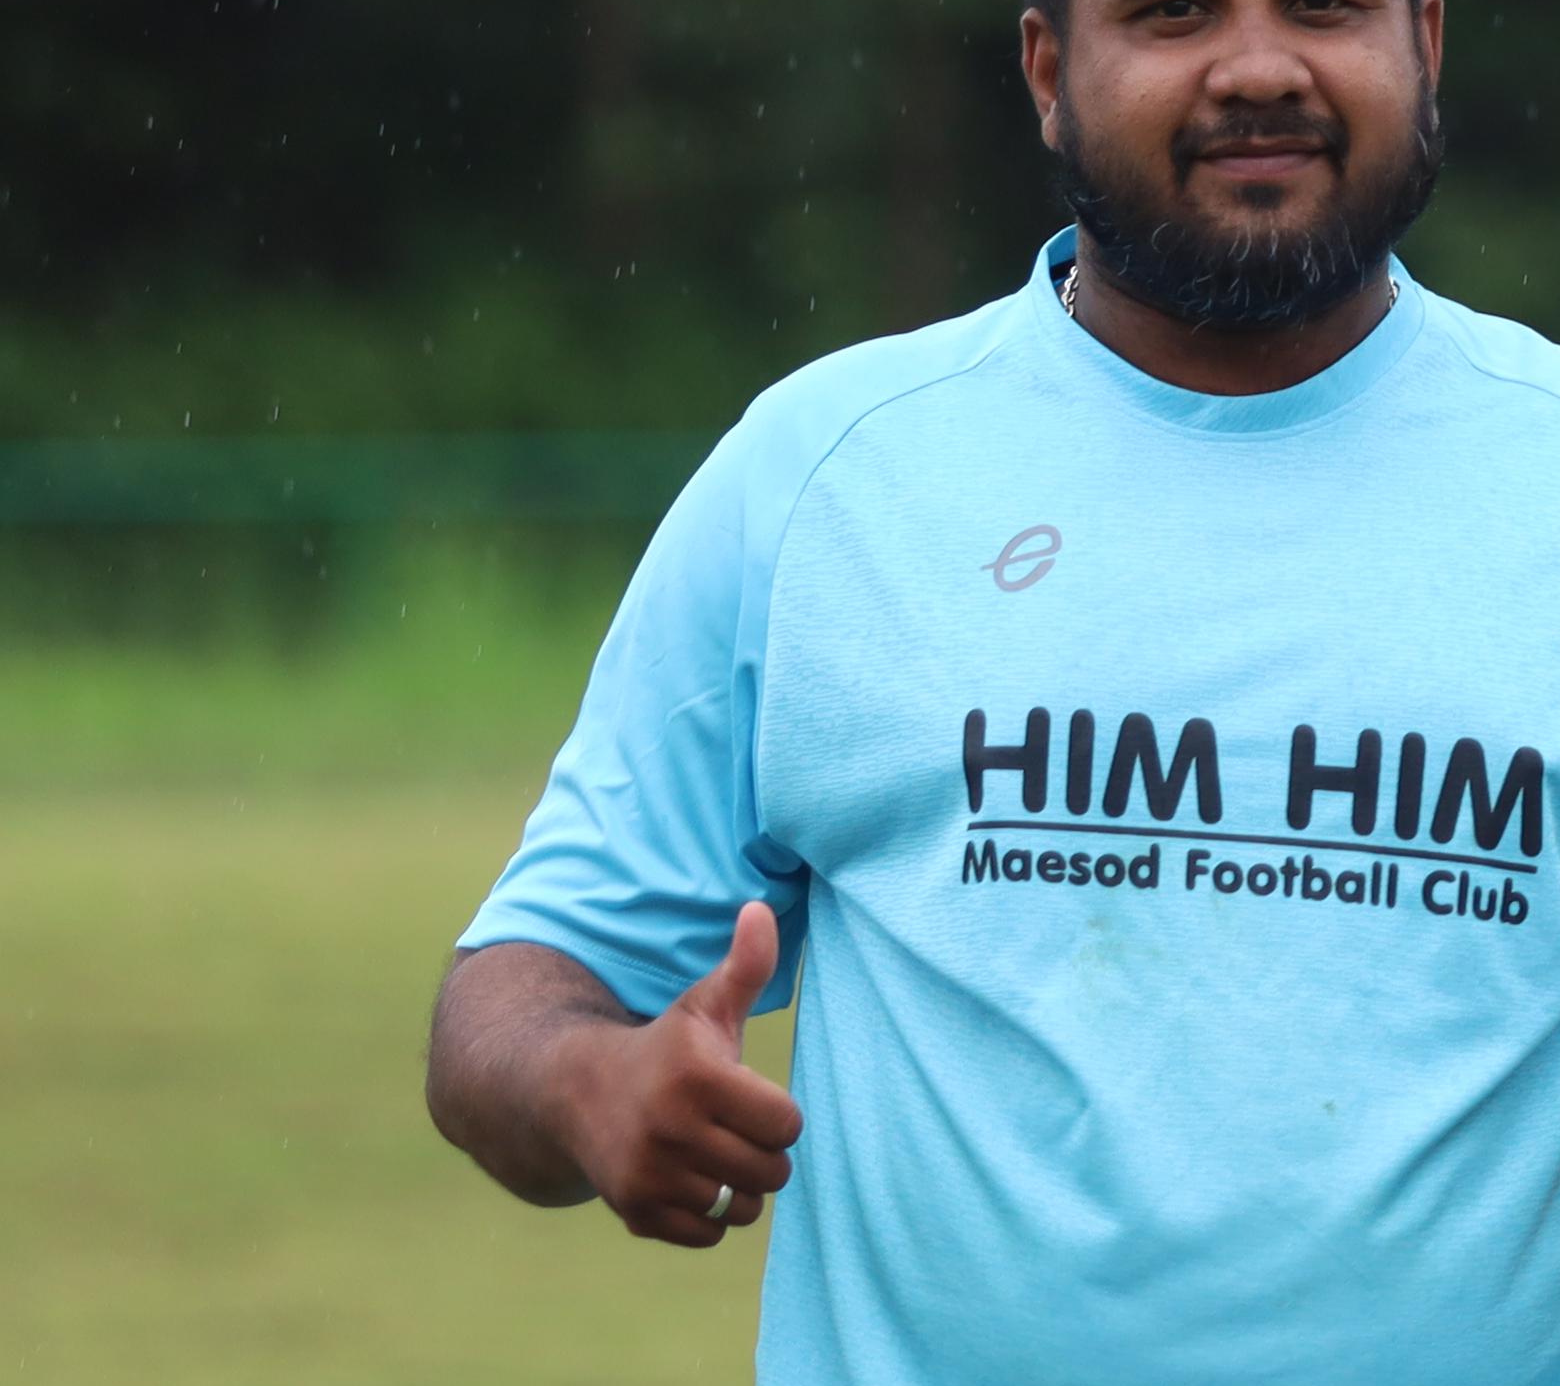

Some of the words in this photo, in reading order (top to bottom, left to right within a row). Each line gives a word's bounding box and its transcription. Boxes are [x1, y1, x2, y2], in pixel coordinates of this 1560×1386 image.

[962, 707, 1223, 824] HIM
[1286, 724, 1545, 858] HIM
[961, 839, 1160, 889] Maesod
[1185, 849, 1399, 909] Football
[1421, 870, 1530, 926] Club
